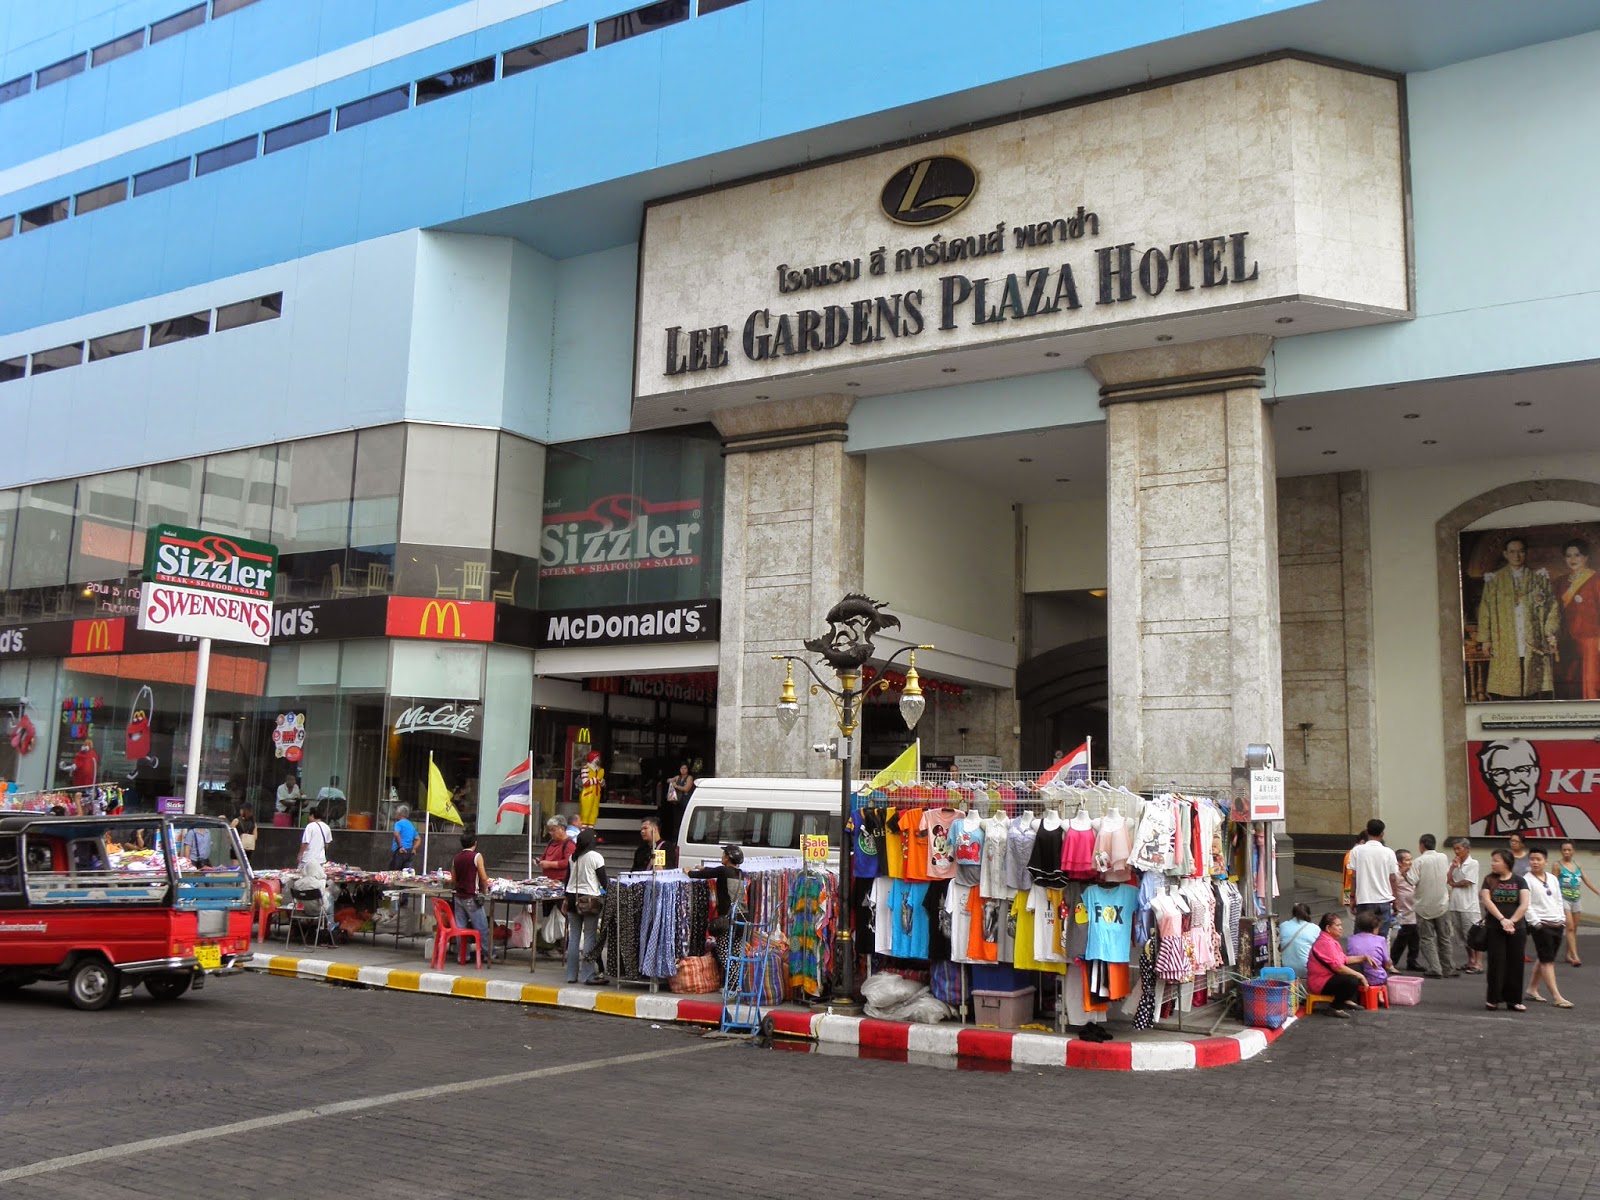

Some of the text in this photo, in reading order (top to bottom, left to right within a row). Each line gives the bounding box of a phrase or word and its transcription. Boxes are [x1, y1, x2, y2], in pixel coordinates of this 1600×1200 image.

[662, 231, 1260, 376] LEE GARDENS PLAZA HOTEL
[541, 514, 700, 568] Sizzler
[157, 544, 272, 590] Sizzler
[542, 557, 693, 577] STEAK SEAFOOD SALAD
[160, 575, 265, 597] STEAK SEAFOOD SALAD
[148, 588, 270, 637] SWENSEN'S
[547, 608, 701, 641] McDonald's
[805, 837, 827, 847] Sale
[807, 848, 825, 857] 160
